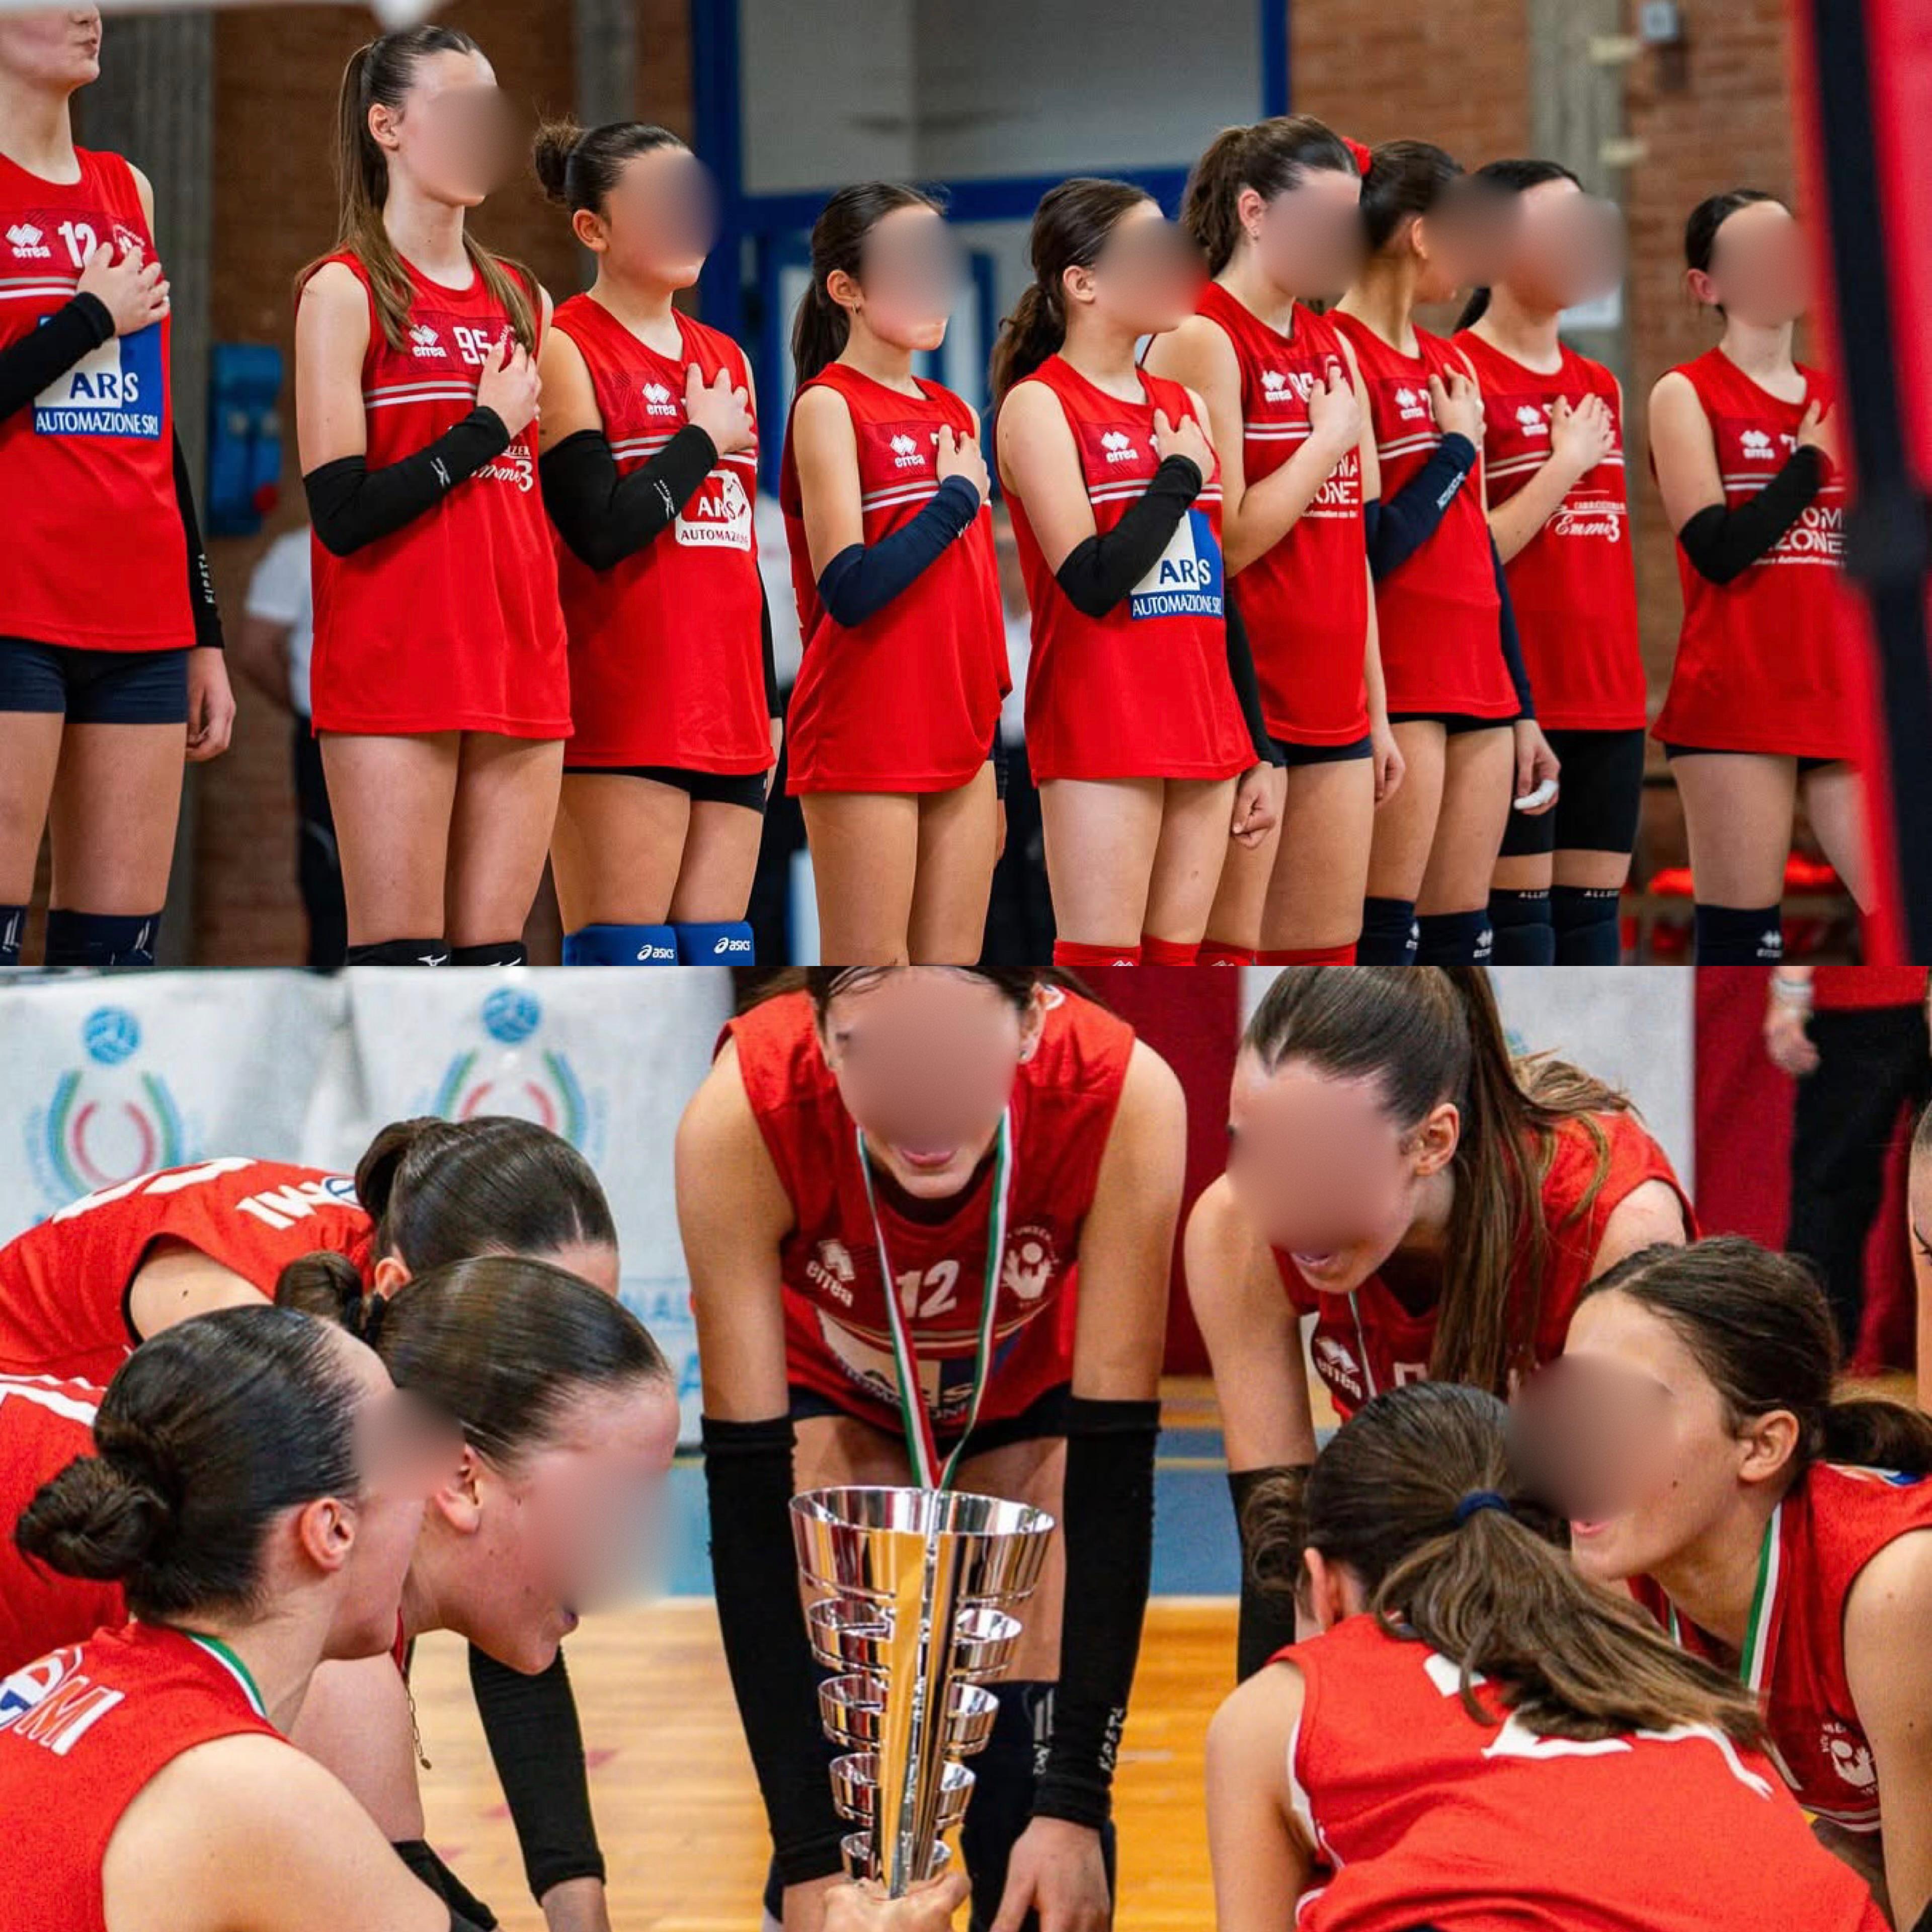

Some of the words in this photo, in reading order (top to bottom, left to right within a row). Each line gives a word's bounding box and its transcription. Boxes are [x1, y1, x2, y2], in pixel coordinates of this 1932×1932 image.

[58, 221, 97, 268] 12
[69, 372, 139, 403] ARS
[36, 411, 141, 433] AUTOMAZIONE
[142, 414, 159, 436] SRL
[1315, 481, 1359, 505] ONE
[698, 497, 736, 520] ARS
[1775, 527, 1847, 554] ZONE
[1159, 558, 1211, 585] ARS
[1133, 594, 1212, 617] AUTOMAZIONE
[653, 948, 675, 959] asics
[729, 940, 750, 951] asics
[897, 1259, 960, 1318] 12
